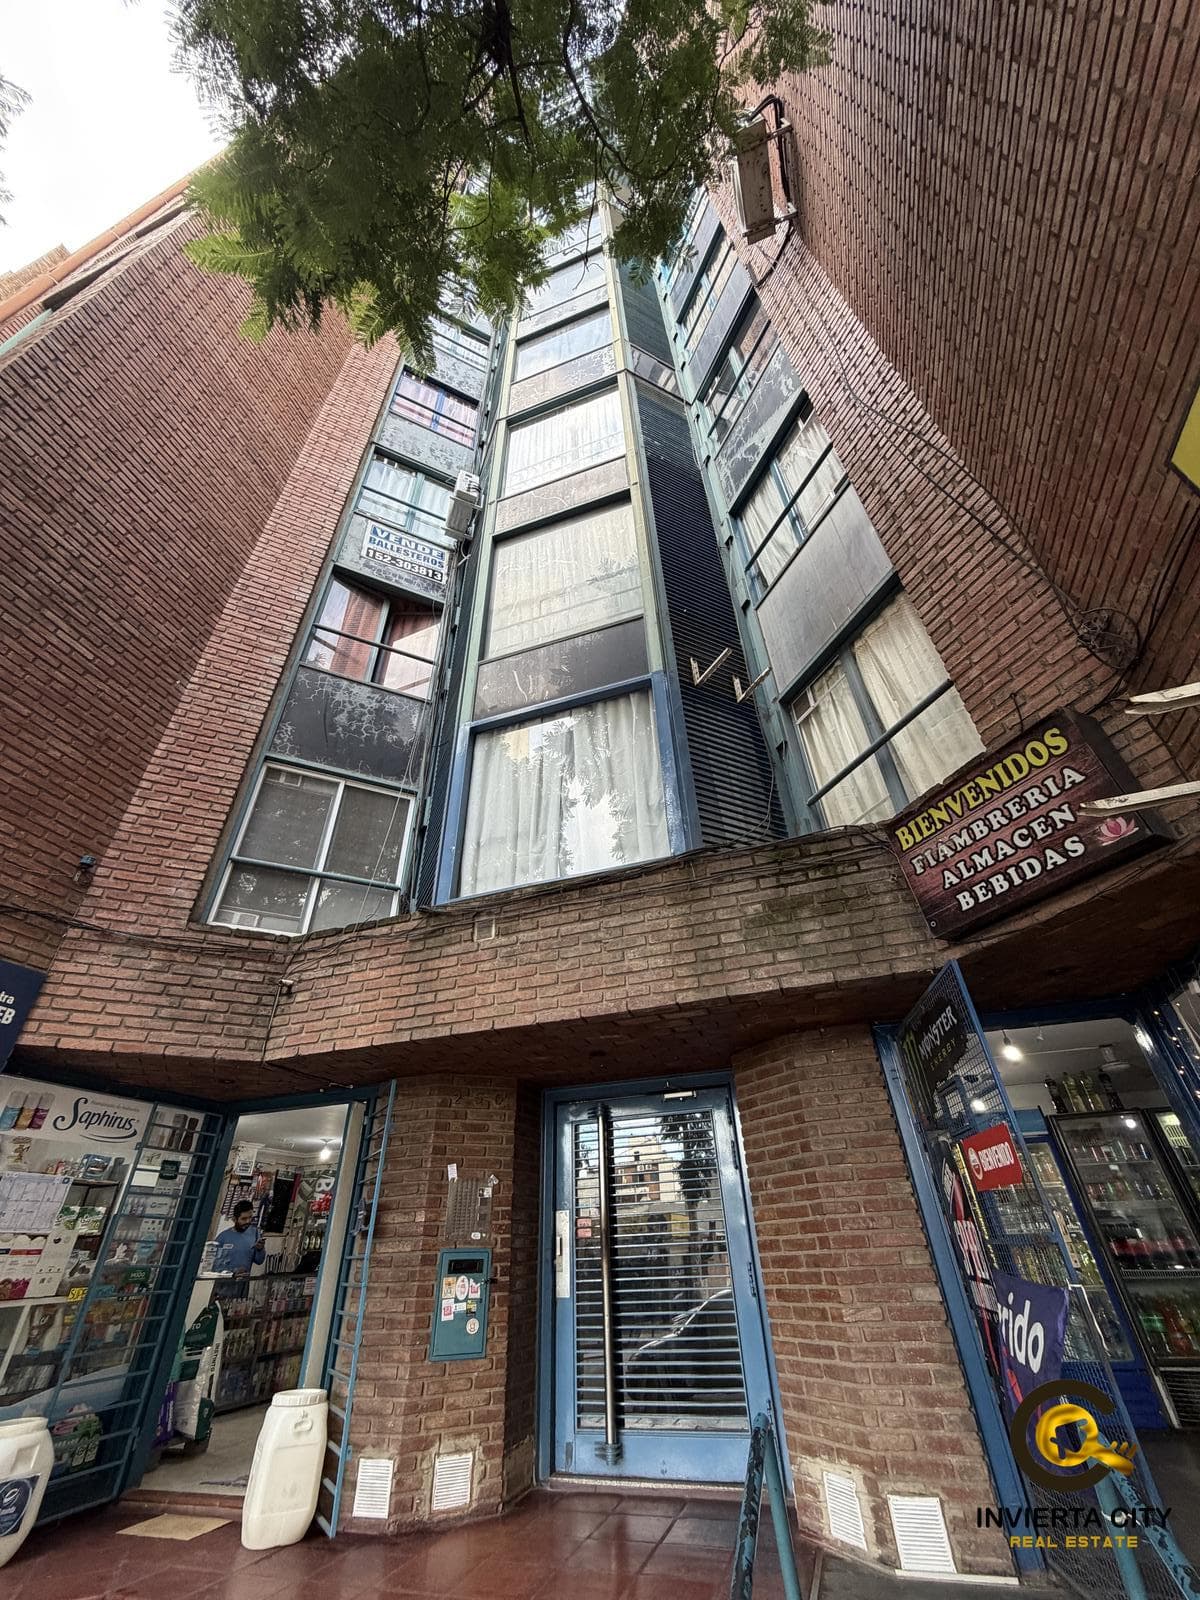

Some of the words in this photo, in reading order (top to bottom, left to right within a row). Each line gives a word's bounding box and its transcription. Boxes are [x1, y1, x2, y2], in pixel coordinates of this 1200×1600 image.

[366, 548, 443, 581] 152-303813
[368, 536, 445, 568] BALLESTEROS
[372, 526, 445, 560] VENDE
[895, 728, 1069, 851] BIENVENIDOS
[911, 766, 1086, 875] FIAMBRERIA
[942, 804, 1077, 890] ALMACEN
[956, 836, 1086, 911] BEBIDAS
[53, 1097, 135, 1131] Saphirus
